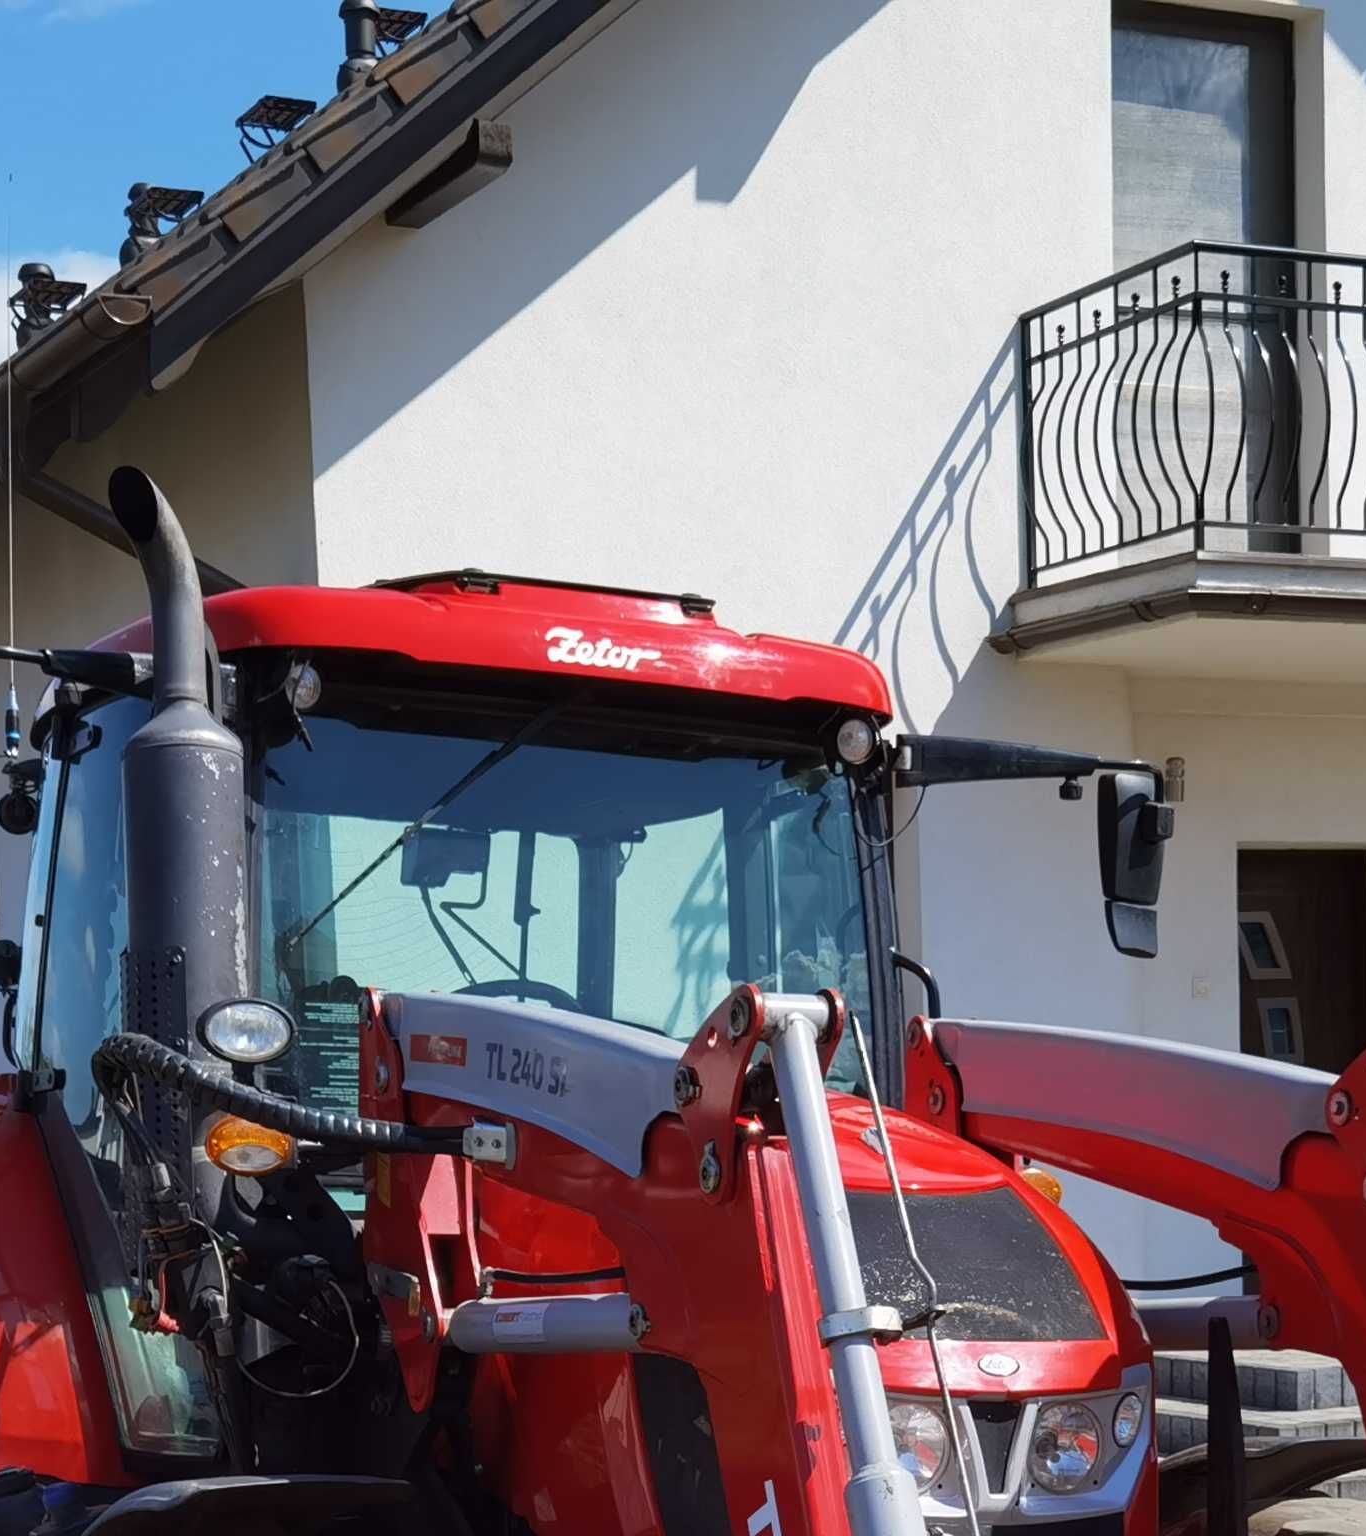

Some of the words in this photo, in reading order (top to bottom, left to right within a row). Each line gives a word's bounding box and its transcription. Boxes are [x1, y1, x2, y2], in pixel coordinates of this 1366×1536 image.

[545, 626, 662, 672] Zetor
[485, 1042, 508, 1081] TL
[510, 1047, 545, 1091] 240
